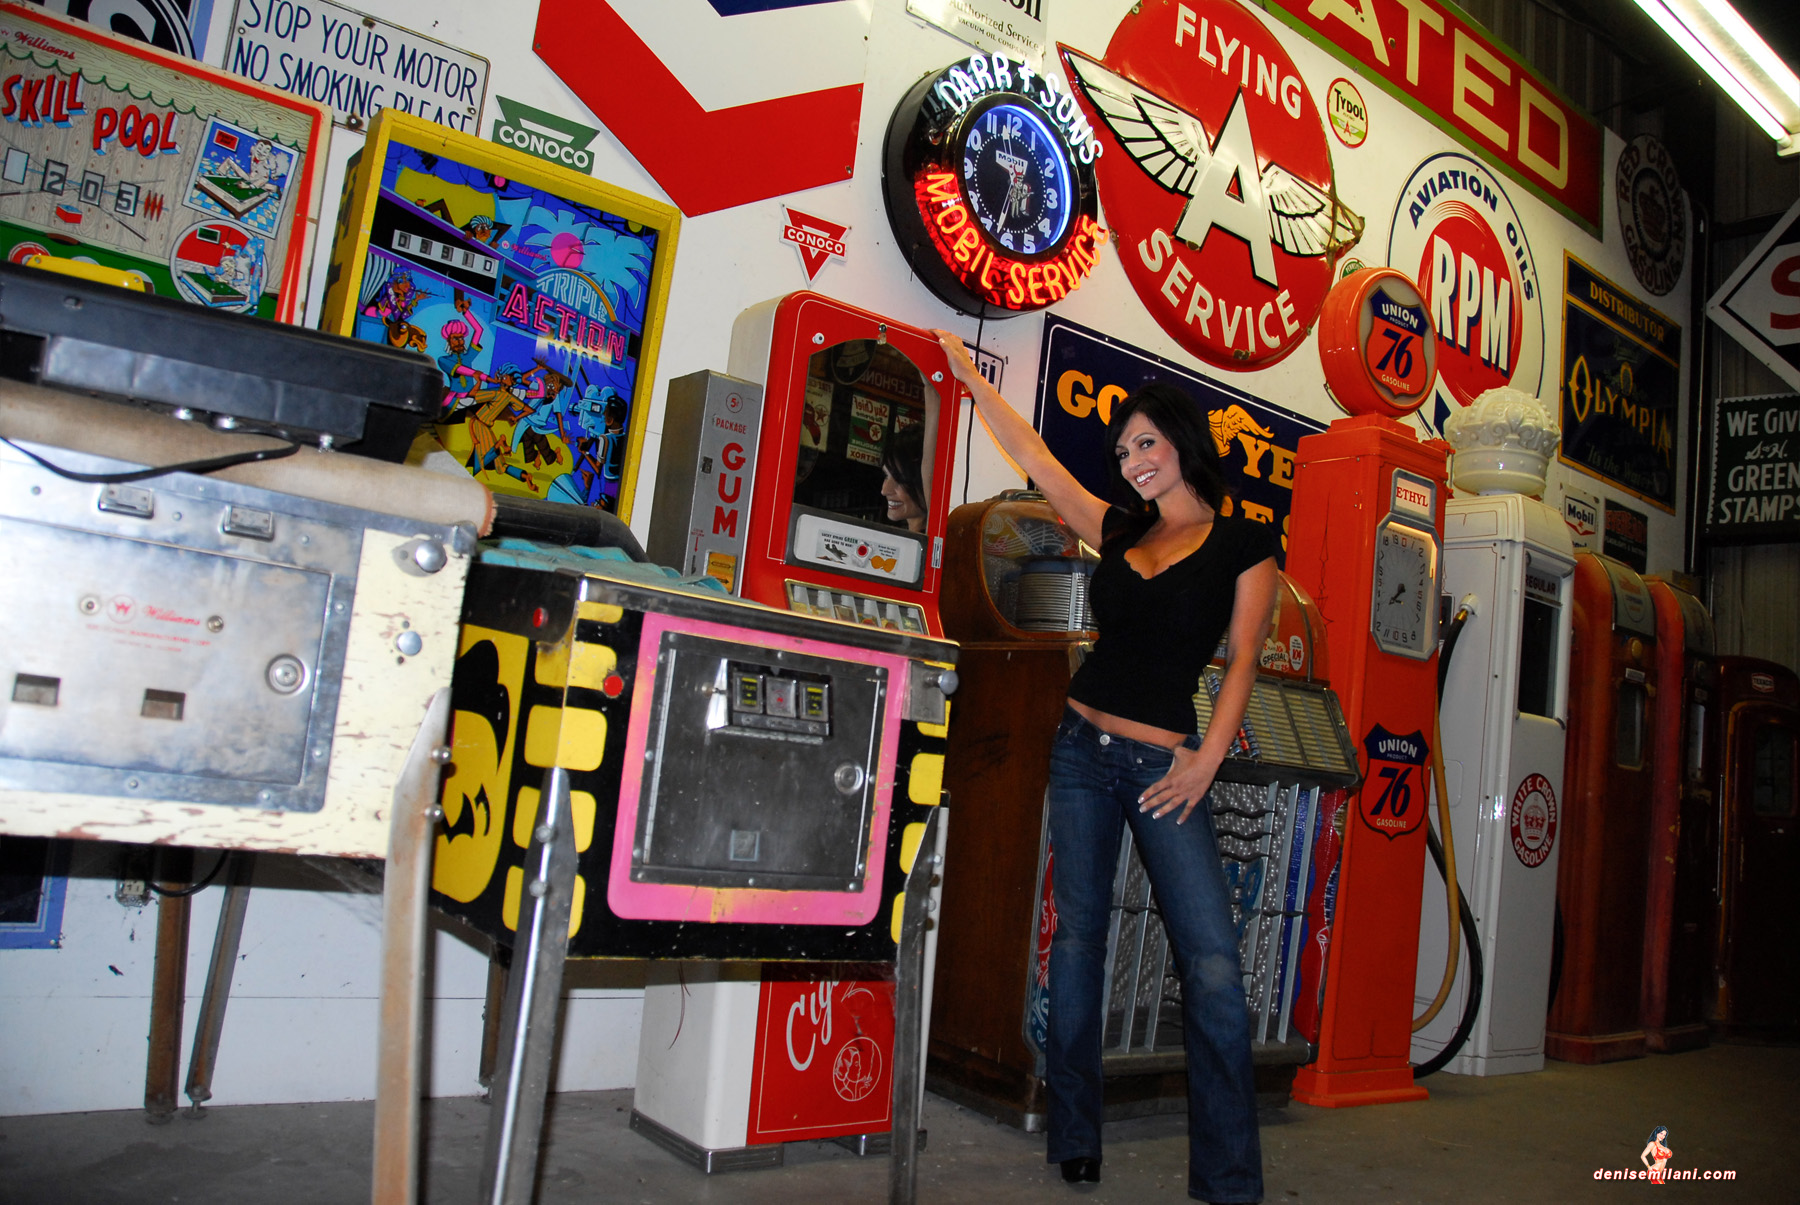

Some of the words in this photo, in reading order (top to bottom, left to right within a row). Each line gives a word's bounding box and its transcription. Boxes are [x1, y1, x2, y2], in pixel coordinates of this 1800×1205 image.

[14, 31, 76, 61] Williams
[949, 0, 1004, 33] Authorized
[1005, 23, 1040, 52] Service
[957, 17, 986, 35] VACUUM
[985, 31, 997, 42] OIL
[997, 37, 1028, 59] COMPANY
[243, 0, 312, 43] STOP
[321, 14, 389, 79] YOUR
[393, 43, 479, 107] MOTOR
[1174, 3, 1302, 120] FLYING
[2, 72, 86, 128] SKILL
[232, 37, 270, 84] NO
[273, 52, 385, 120] SMOKING
[393, 91, 473, 134] PLEASE
[939, 51, 1012, 115] DARR
[1040, 72, 1104, 165] SONS
[1333, 88, 1365, 122] TYDOL
[93, 105, 181, 159] POOL
[498, 124, 590, 169] CONOCO
[998, 153, 1026, 168] Mobil
[1618, 145, 1641, 203] RED
[1646, 139, 1685, 242] CROWN
[510, 243, 548, 262] Williams
[786, 227, 844, 256] CONOCO
[926, 173, 994, 290] MOBIL
[1008, 215, 1110, 306] SERVICE
[1408, 169, 1498, 230] AVIATION
[1505, 222, 1535, 302] OILS
[1624, 224, 1683, 291] GASOLINE
[536, 272, 608, 324] TRIPLE
[1137, 227, 1300, 355] SERVICE
[1431, 234, 1513, 375] RPM
[1589, 280, 1665, 343] DISTRIBUTOR
[502, 281, 627, 363] ACTION
[1381, 303, 1419, 330] UNION
[1389, 316, 1410, 329] PRODUCT
[1375, 328, 1416, 378] 76
[1381, 374, 1411, 392] GASOLINE
[715, 417, 748, 436] PACKAGE
[1568, 355, 1671, 469] OLYMPIA
[1726, 410, 1759, 437] WE
[711, 442, 747, 539] GUM
[1395, 486, 1429, 508] ETHYL
[1728, 461, 1800, 493] GREEN
[1568, 503, 1595, 525] Mobil
[1525, 574, 1556, 595] REGULAR
[143, 604, 201, 627] Williams
[1262, 652, 1287, 666] SPECIAL
[1378, 738, 1418, 758] UNION
[1370, 766, 1413, 818] 76
[1511, 777, 1533, 827] WHITE
[1535, 776, 1556, 824] CROWN
[1376, 817, 1407, 830] GASOLINE
[1513, 833, 1554, 867] GASOLINE
